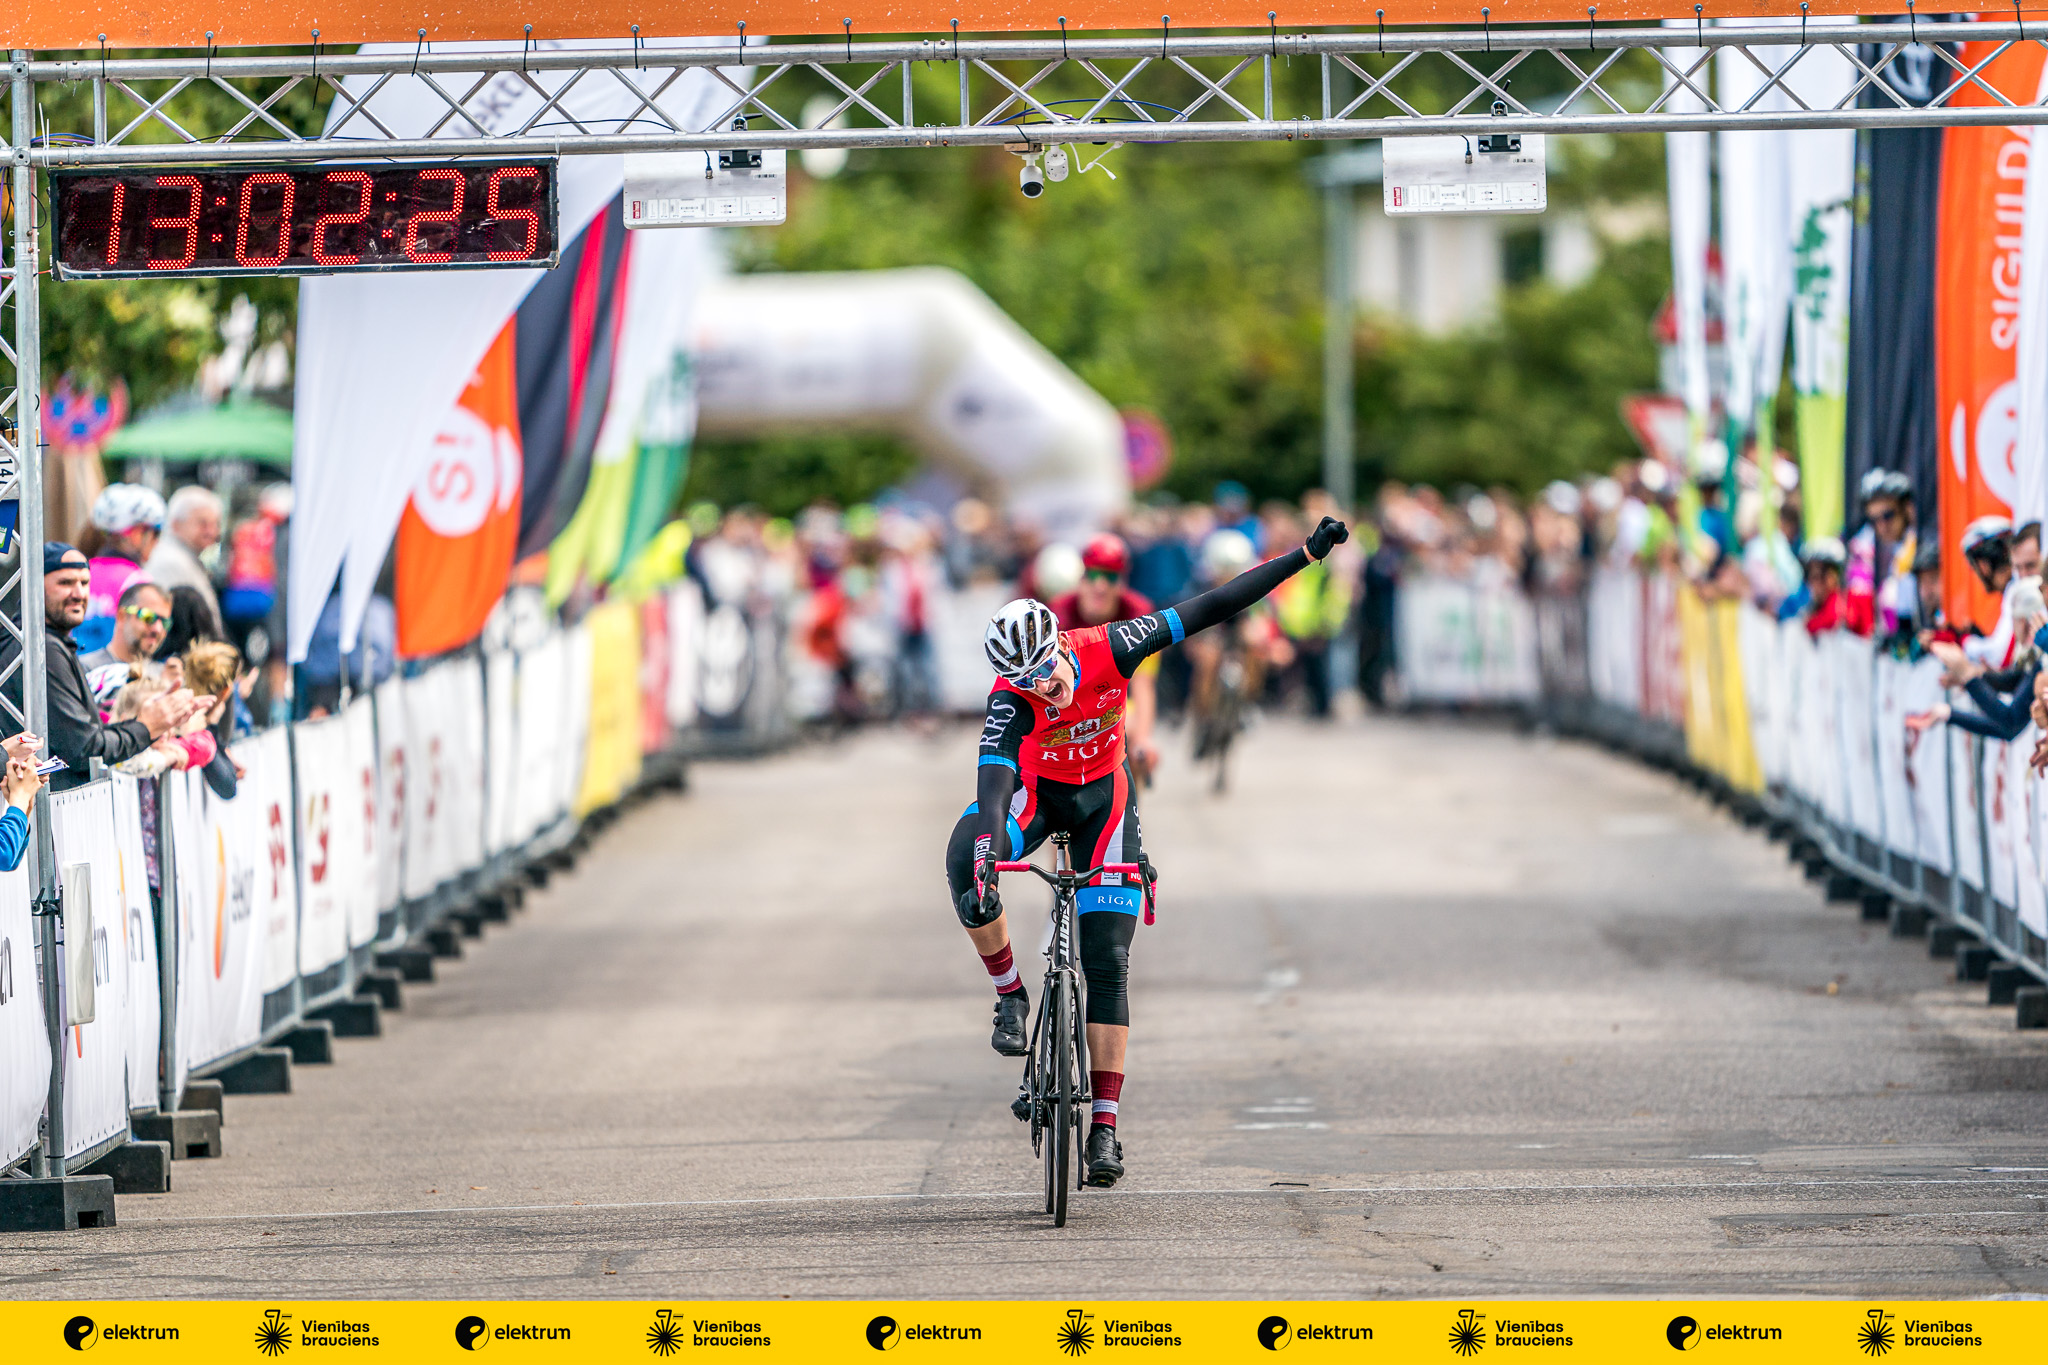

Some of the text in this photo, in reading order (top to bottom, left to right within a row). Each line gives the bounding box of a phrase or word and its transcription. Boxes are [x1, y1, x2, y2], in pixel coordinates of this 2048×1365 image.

[107, 166, 539, 270] 13:02:25
[1115, 615, 1158, 652] RRS
[979, 699, 1016, 748] RRS
[1059, 899, 1070, 964] GIANT
